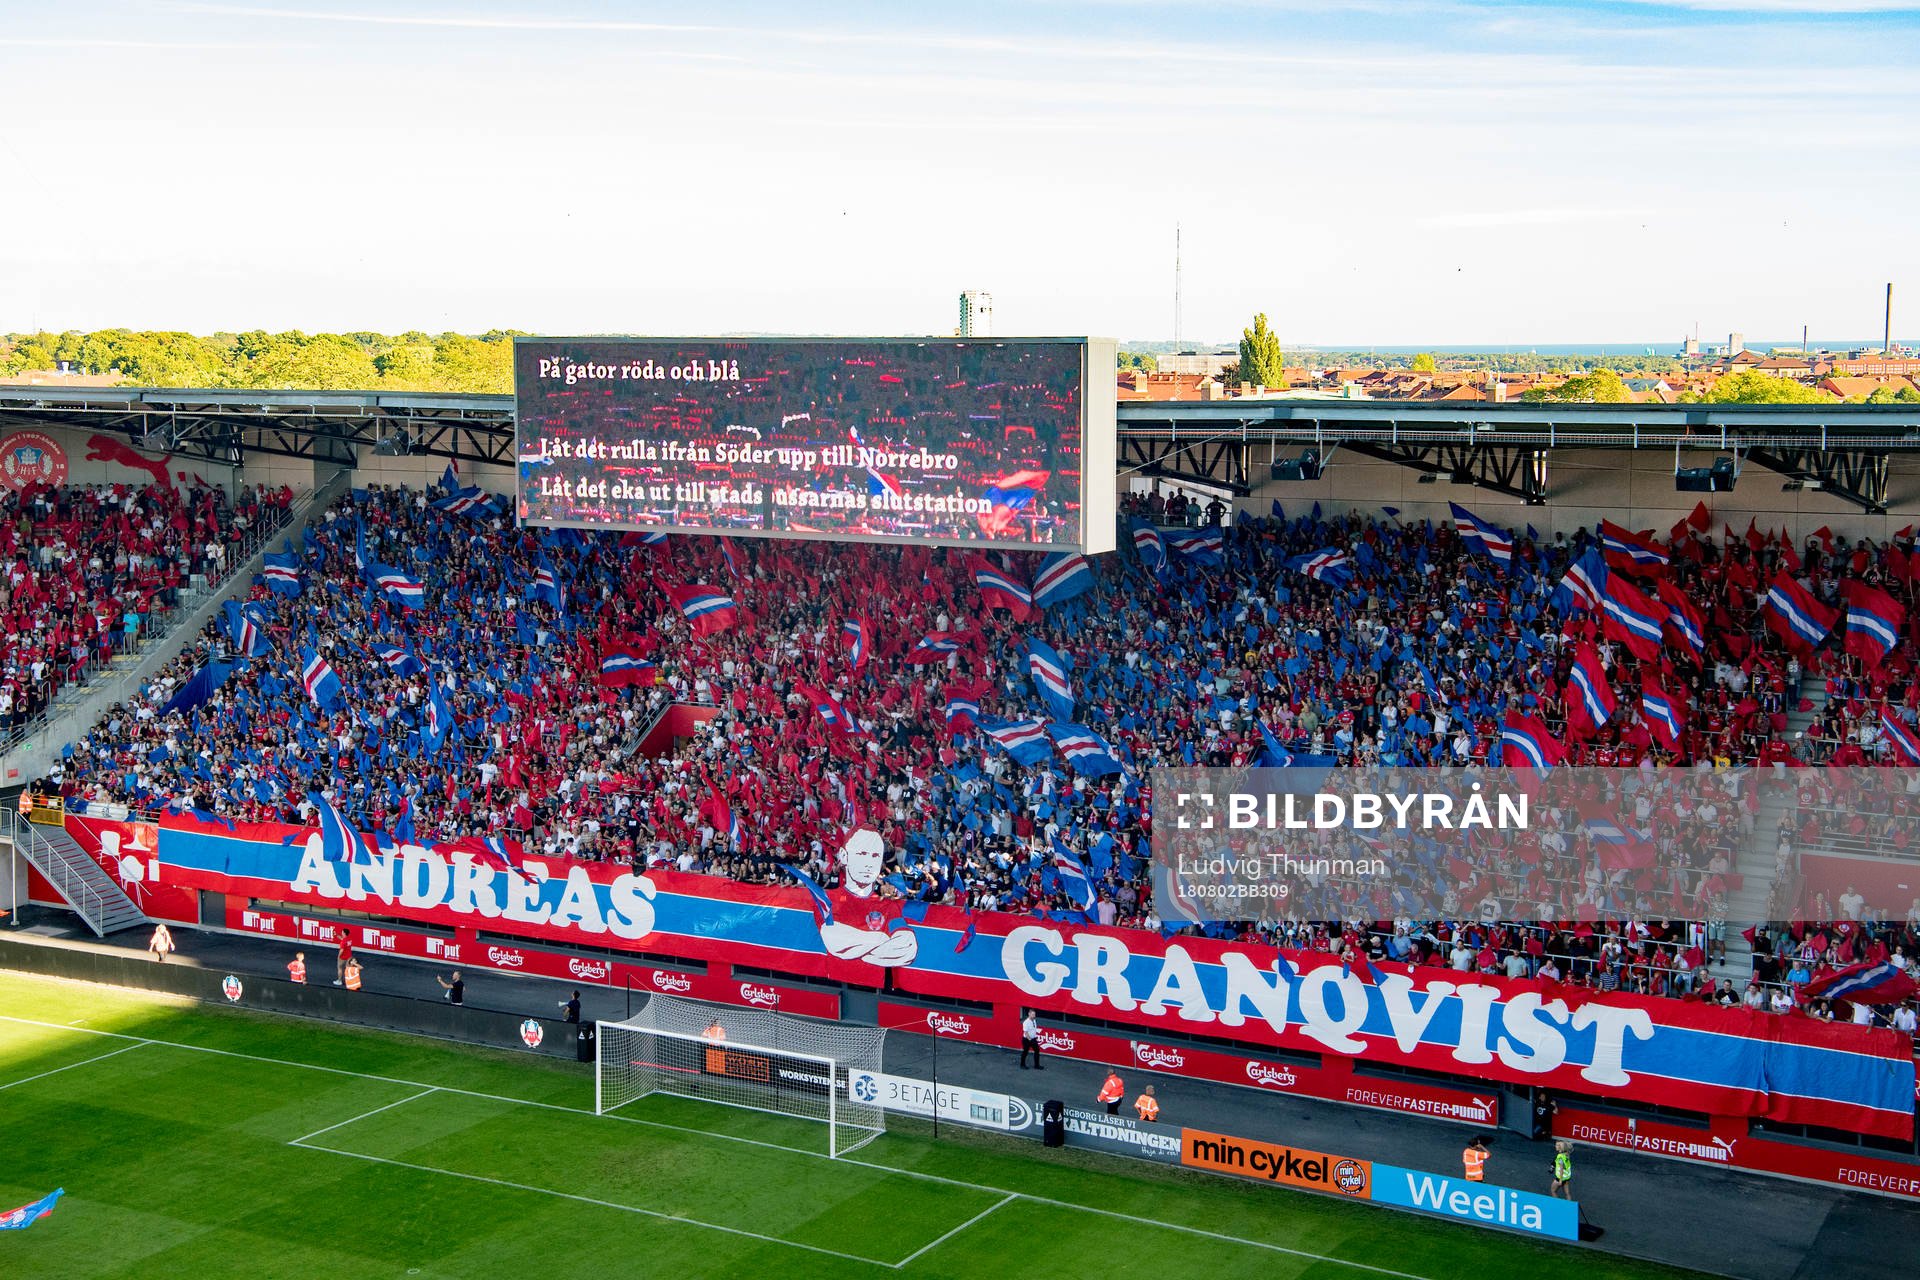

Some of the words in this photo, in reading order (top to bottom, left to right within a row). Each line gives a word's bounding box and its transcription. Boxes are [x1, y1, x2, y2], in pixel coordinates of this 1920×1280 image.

[539, 358, 561, 378] På
[565, 361, 617, 385] gator
[621, 360, 665, 380] röda
[670, 360, 705, 381] och
[708, 359, 741, 382] blå
[540, 437, 572, 459] Låt
[575, 438, 607, 460] det
[611, 439, 657, 461] rulla
[661, 440, 711, 463] ifrån
[715, 443, 773, 465] Söder
[778, 448, 817, 471] upp
[821, 445, 855, 467] till
[541, 476, 572, 498] Låt
[576, 477, 608, 499] det
[611, 478, 646, 501] eka
[649, 484, 672, 502] ut
[675, 482, 706, 504] till
[871, 489, 993, 515] slutstation
[290, 832, 657, 940] ANDREAS
[488, 946, 524, 967] Carlsberg
[568, 958, 606, 979] Carlsberg
[652, 970, 691, 992] Carlsberg
[740, 983, 780, 1005] Carlsberg
[1002, 925, 1654, 1088] GRANQVIST
[926, 1011, 970, 1034] Carlsberg
[1035, 1028, 1074, 1051] arlsberg
[1136, 1044, 1184, 1069] Carlsberg
[1246, 1061, 1296, 1086] Carlsberg
[888, 1082, 961, 1110] 3ETAGE
[1035, 1112, 1181, 1152] LKALTIDNINGEN
[1126, 1120, 1136, 1129] VI
[1193, 1138, 1244, 1167] min
[1249, 1149, 1328, 1183] cykel
[1339, 1165, 1354, 1175] min
[1341, 1175, 1361, 1187] cykel
[1406, 1173, 1543, 1230] Weelia
